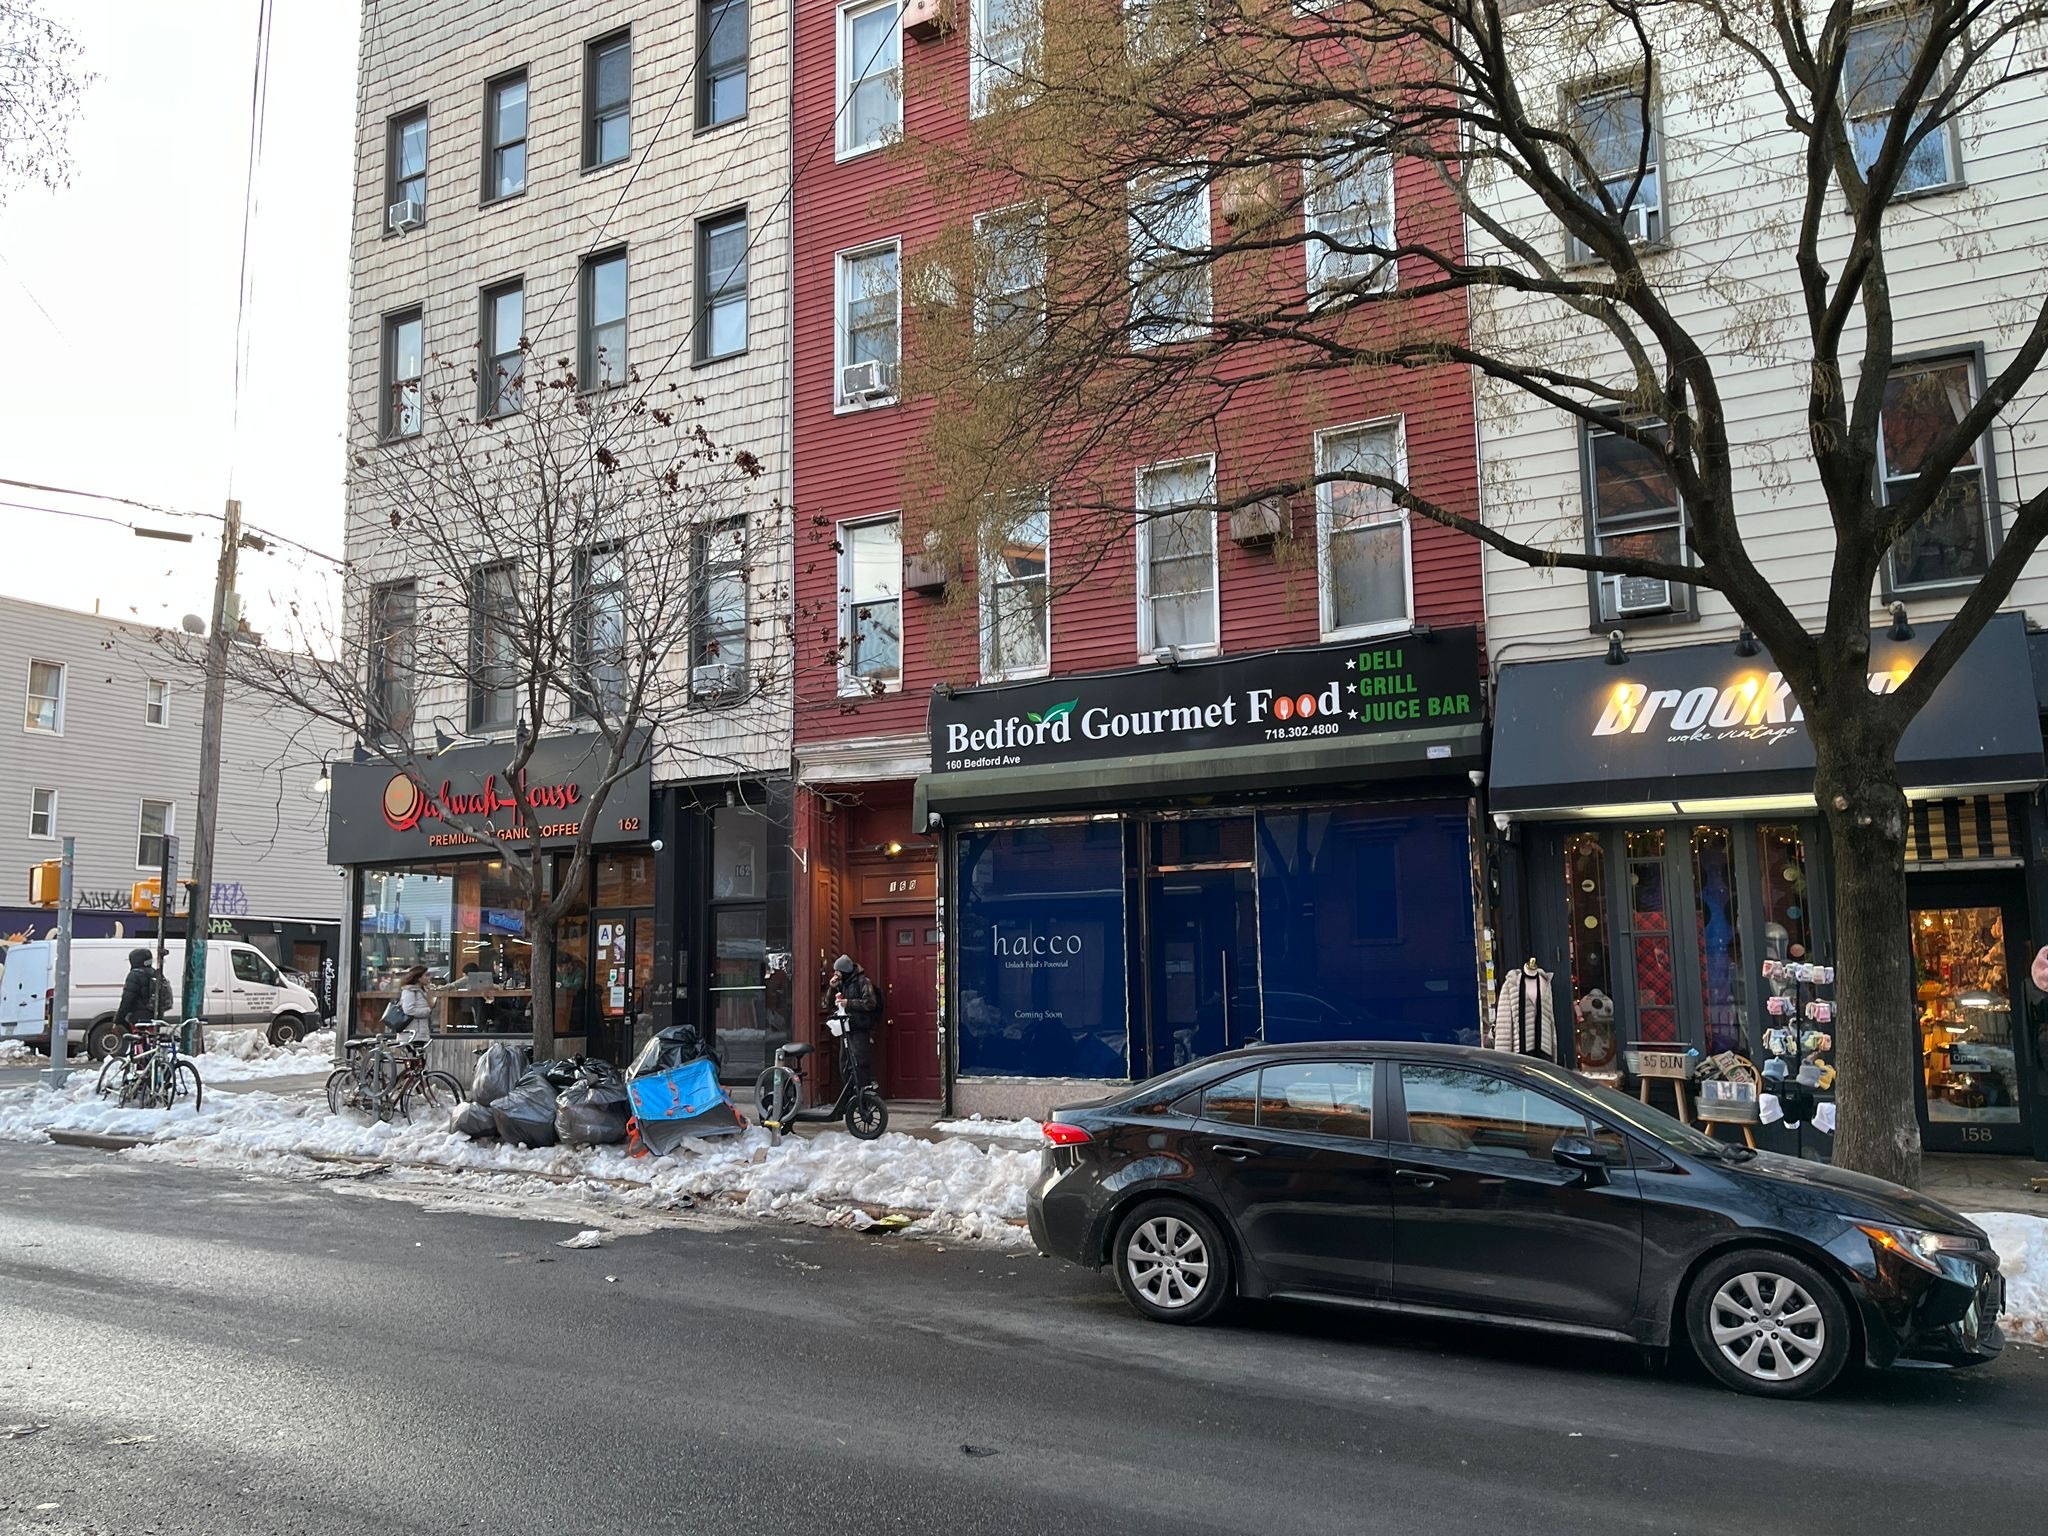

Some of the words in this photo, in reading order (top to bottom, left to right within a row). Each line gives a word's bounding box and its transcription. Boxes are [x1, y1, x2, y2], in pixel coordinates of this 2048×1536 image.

[1359, 649, 1403, 672] DELI
[1360, 674, 1418, 698] GRILL
[1360, 699, 1421, 724] JUICE
[1428, 694, 1471, 717] BAR
[946, 711, 1072, 754] Bedford
[1081, 695, 1237, 741] Gourmet
[1246, 681, 1343, 724] Food
[1265, 723, 1339, 741] 718.302.4800
[1667, 724, 1714, 744] woke
[1717, 723, 1798, 746] vintage
[946, 760, 962, 770] 160
[964, 757, 1001, 769] Bedford
[1002, 755, 1021, 765] Ave
[618, 817, 639, 831] 162
[735, 864, 751, 877] 162
[890, 880, 917, 892] 160
[601, 927, 610, 941] A
[991, 924, 1082, 956] hacco
[1005, 961, 1024, 969] Unlock
[1043, 959, 1069, 968] Potential
[1014, 1009, 1043, 1021] Coming
[1044, 1009, 1063, 1019] Soon
[1643, 1055, 1658, 1069] $5
[1659, 1055, 1684, 1070] BIN
[1953, 1053, 1978, 1064] Open
[1961, 1127, 1993, 1143] 158
